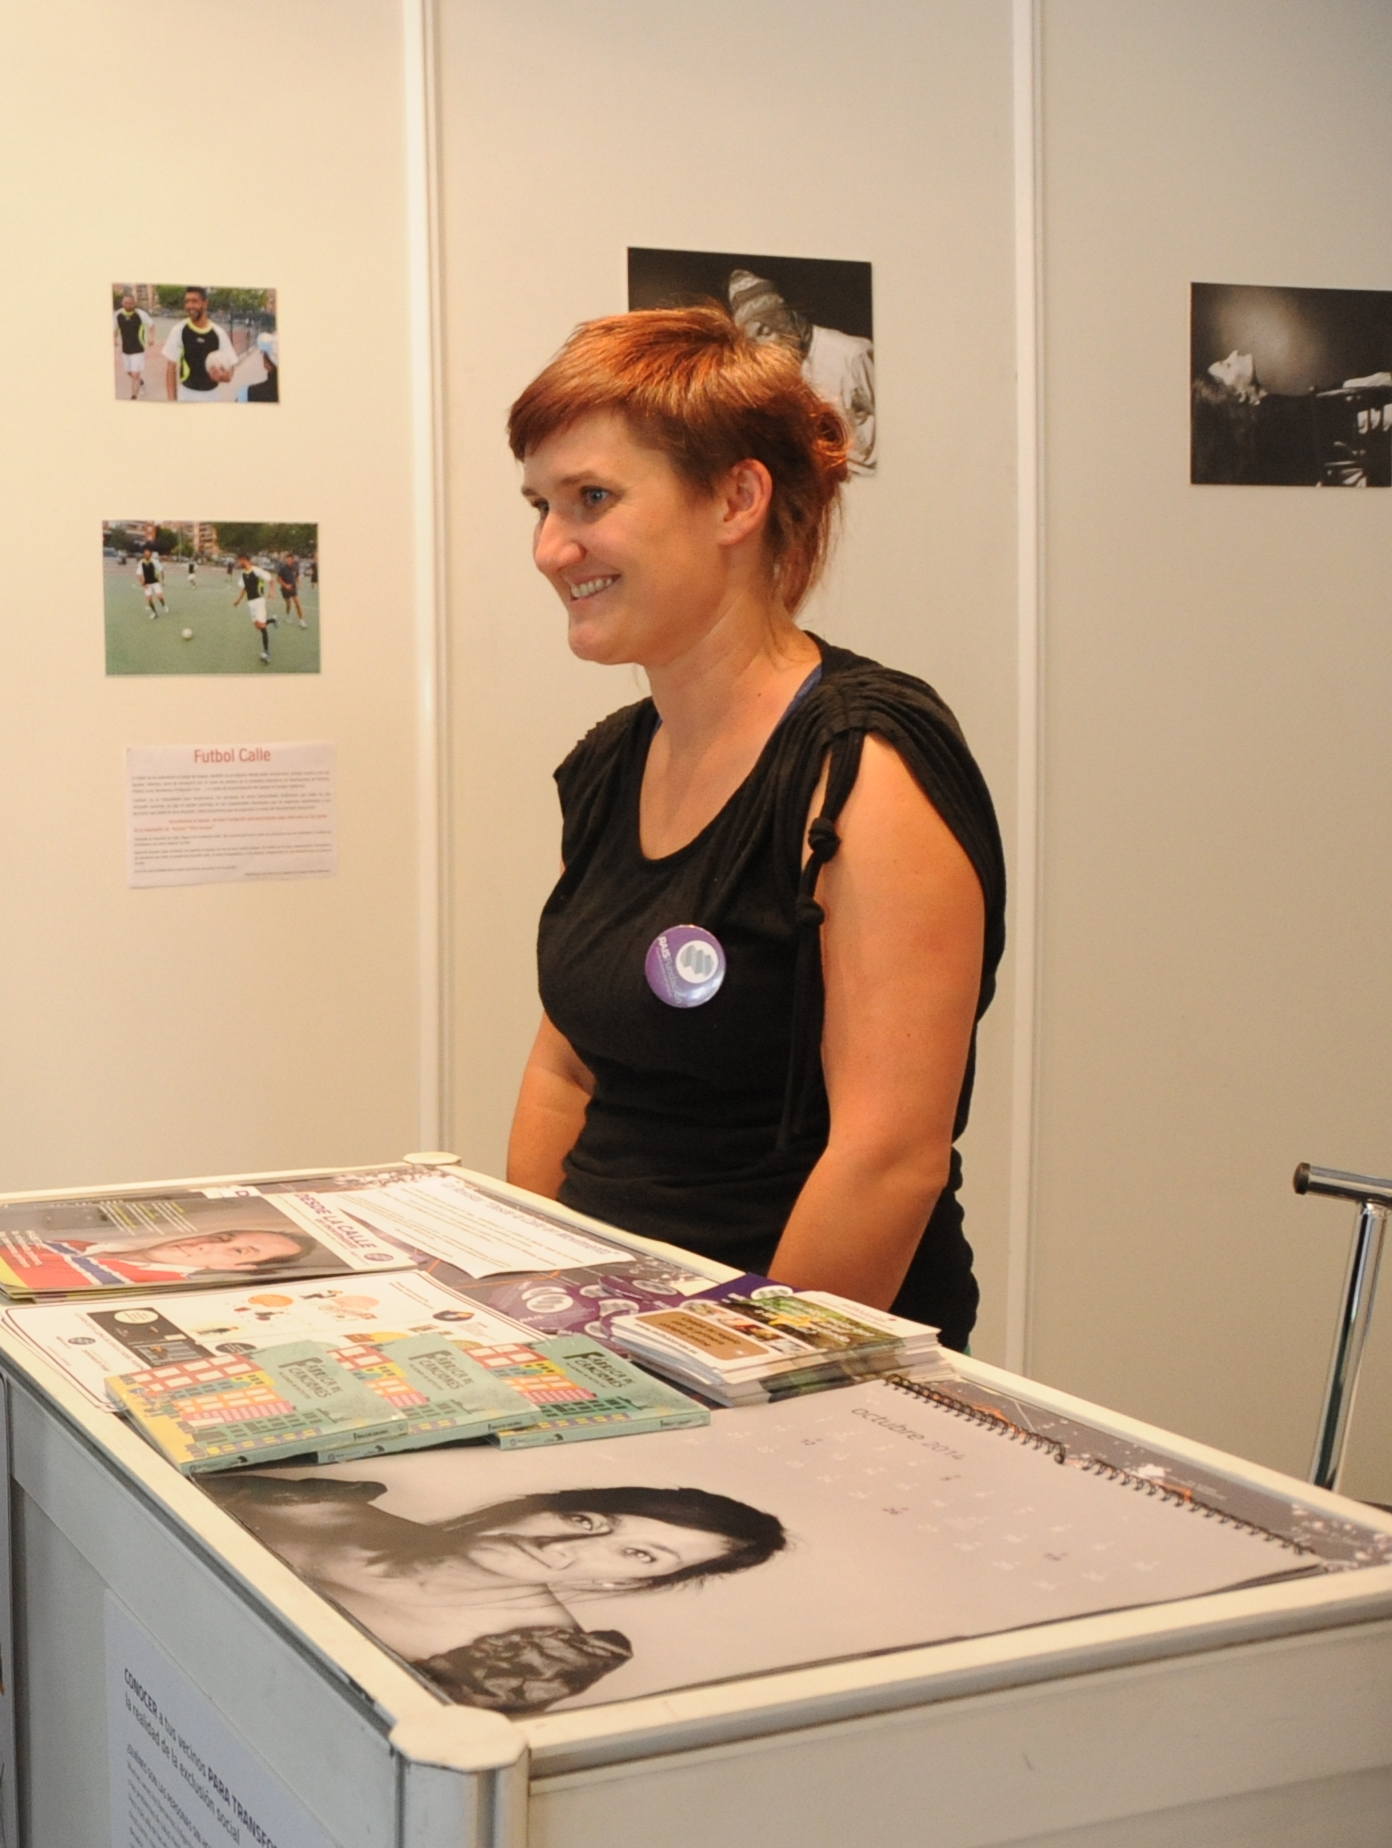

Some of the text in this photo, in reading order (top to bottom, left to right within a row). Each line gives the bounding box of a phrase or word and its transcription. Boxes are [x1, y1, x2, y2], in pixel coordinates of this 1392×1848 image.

[194, 748, 272, 764] Futbol Calle
[322, 1216, 344, 1225] LA
[337, 1225, 377, 1249] CALLE
[851, 1408, 966, 1460] octubre 2014
[124, 1667, 158, 1717] CONOCER
[164, 1716, 177, 1741] tus
[178, 1733, 207, 1777] vecinos
[208, 1765, 231, 1804] PARA
[231, 1794, 278, 1848] TRANSFO
[125, 1692, 132, 1712] la
[132, 1706, 160, 1746] realidad
[171, 1747, 178, 1769] la
[180, 1762, 215, 1815] exclusión
[216, 1807, 240, 1845] social
